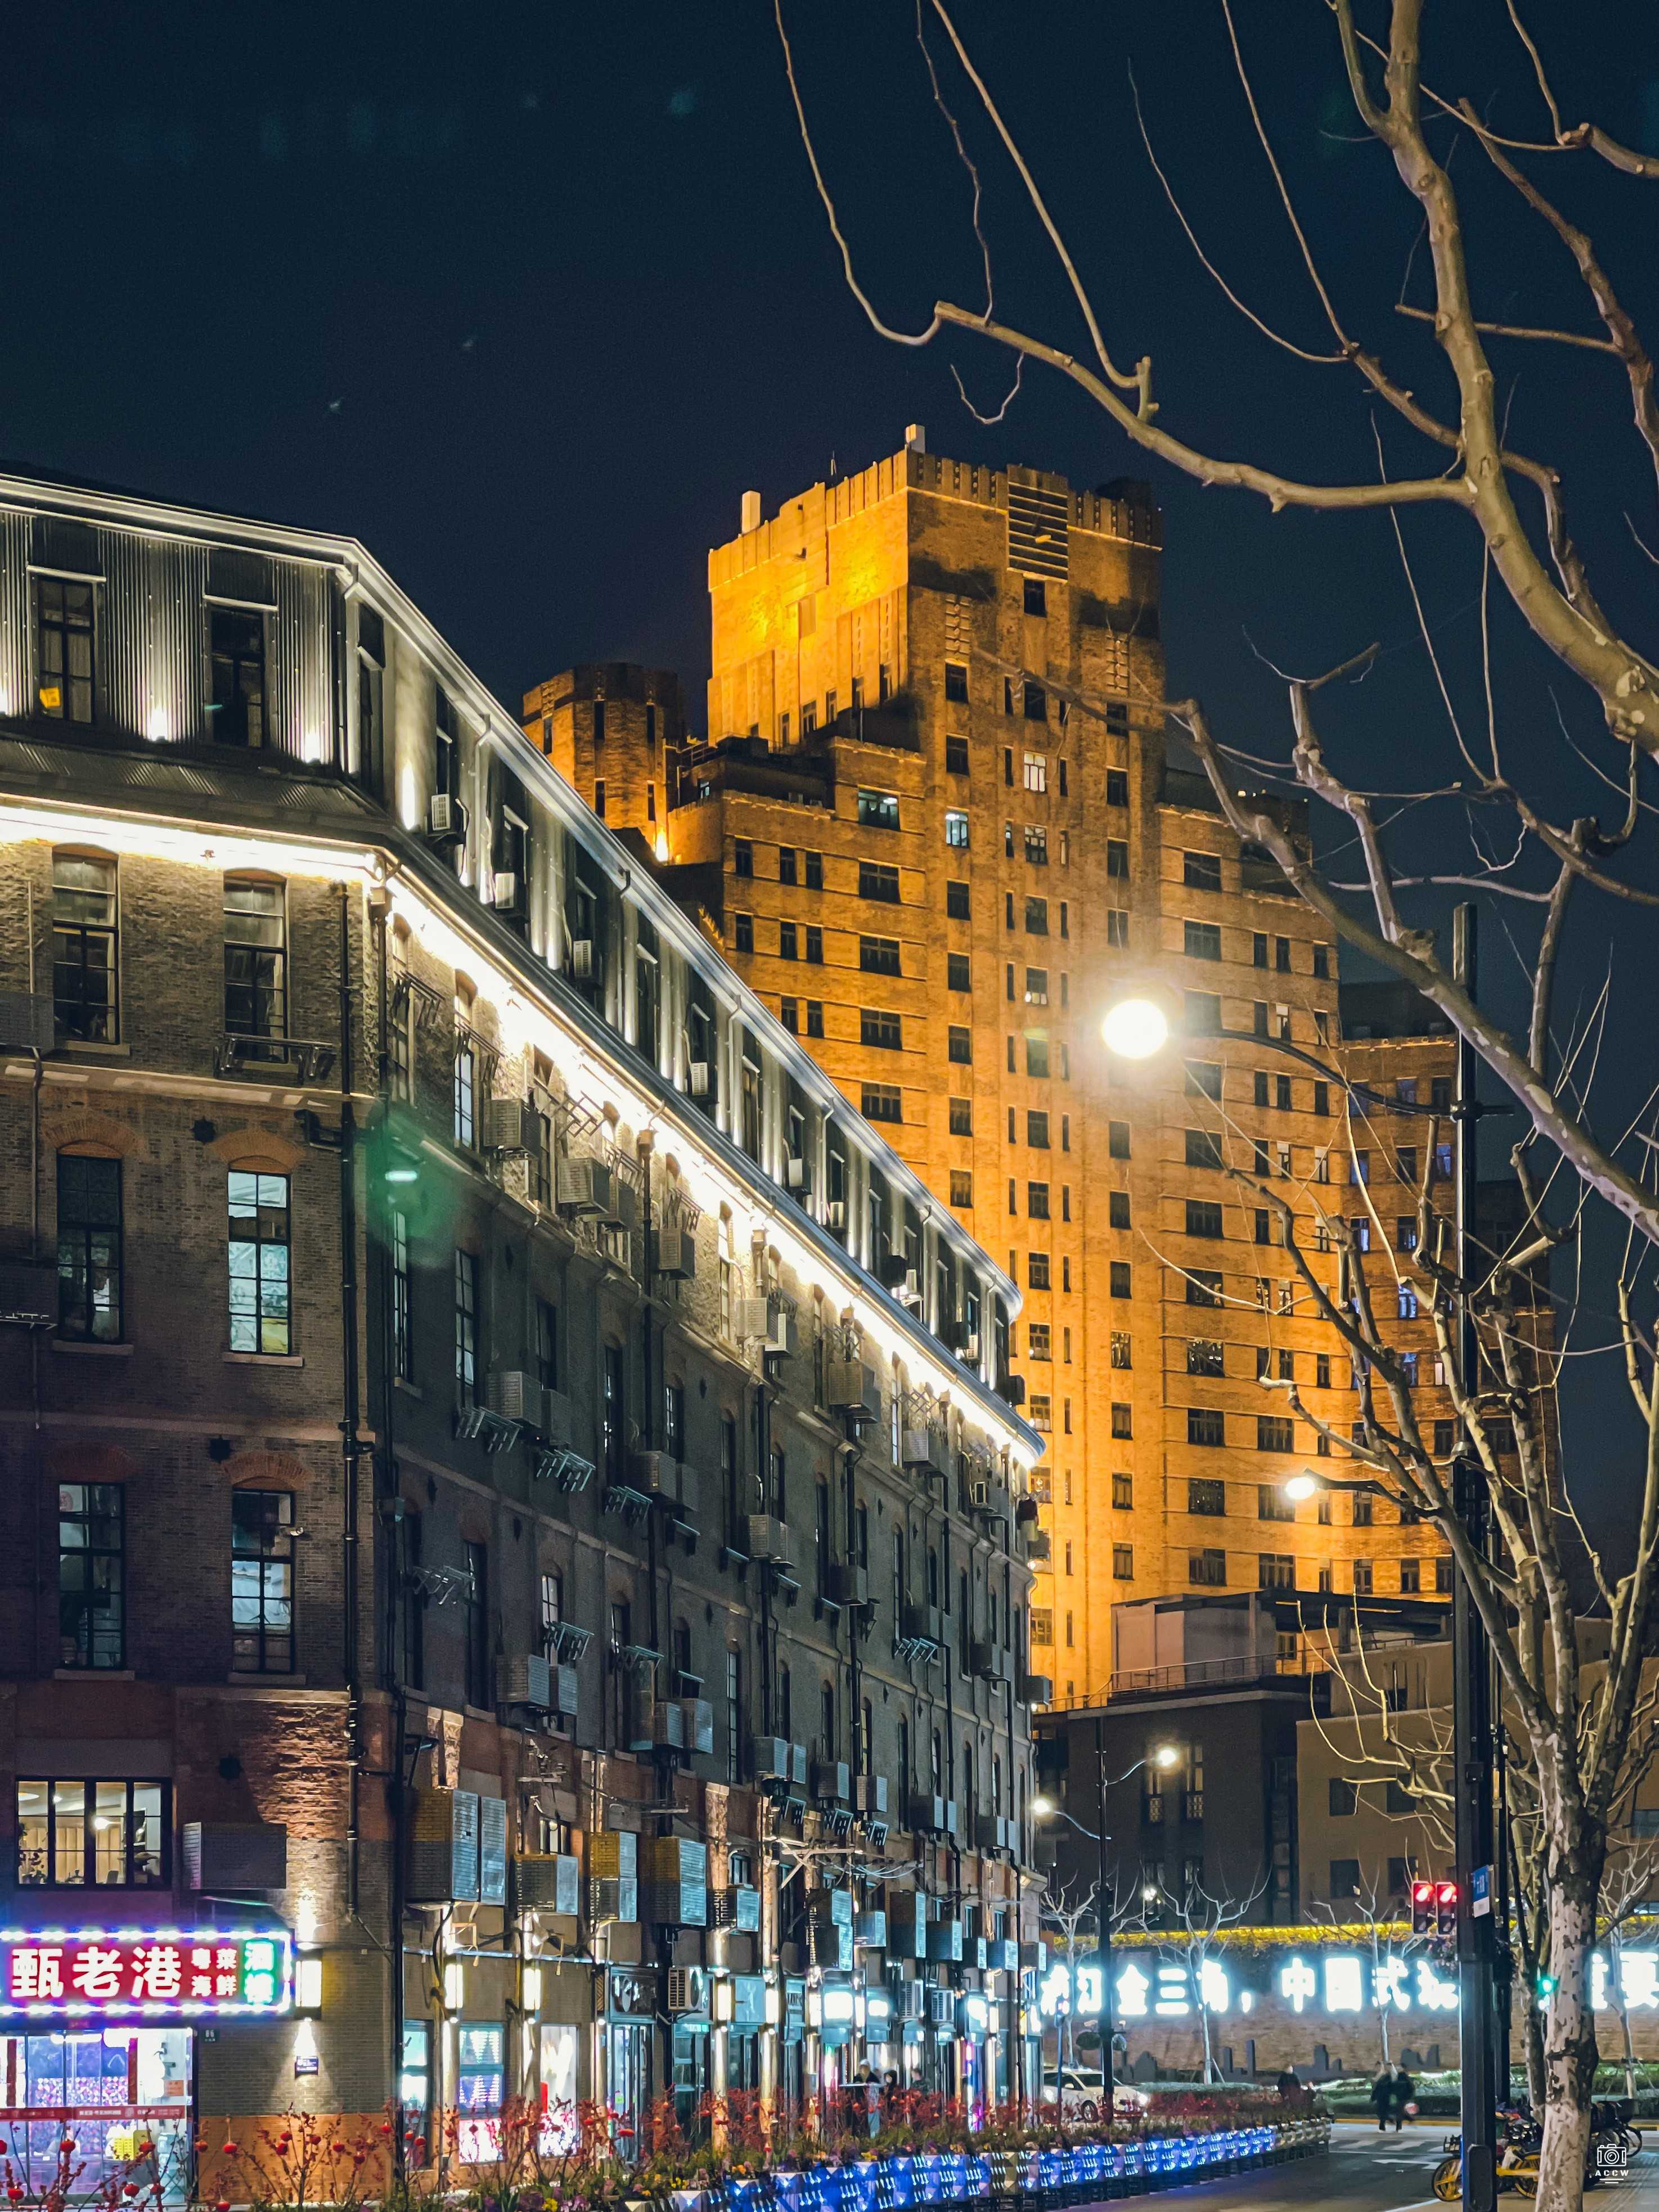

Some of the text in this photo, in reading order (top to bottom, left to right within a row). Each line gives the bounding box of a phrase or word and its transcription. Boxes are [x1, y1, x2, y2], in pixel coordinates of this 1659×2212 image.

[191, 1948, 237, 1970] 粤菜
[11, 1946, 182, 1998] 甄老港
[191, 1975, 237, 1997] 海鲜
